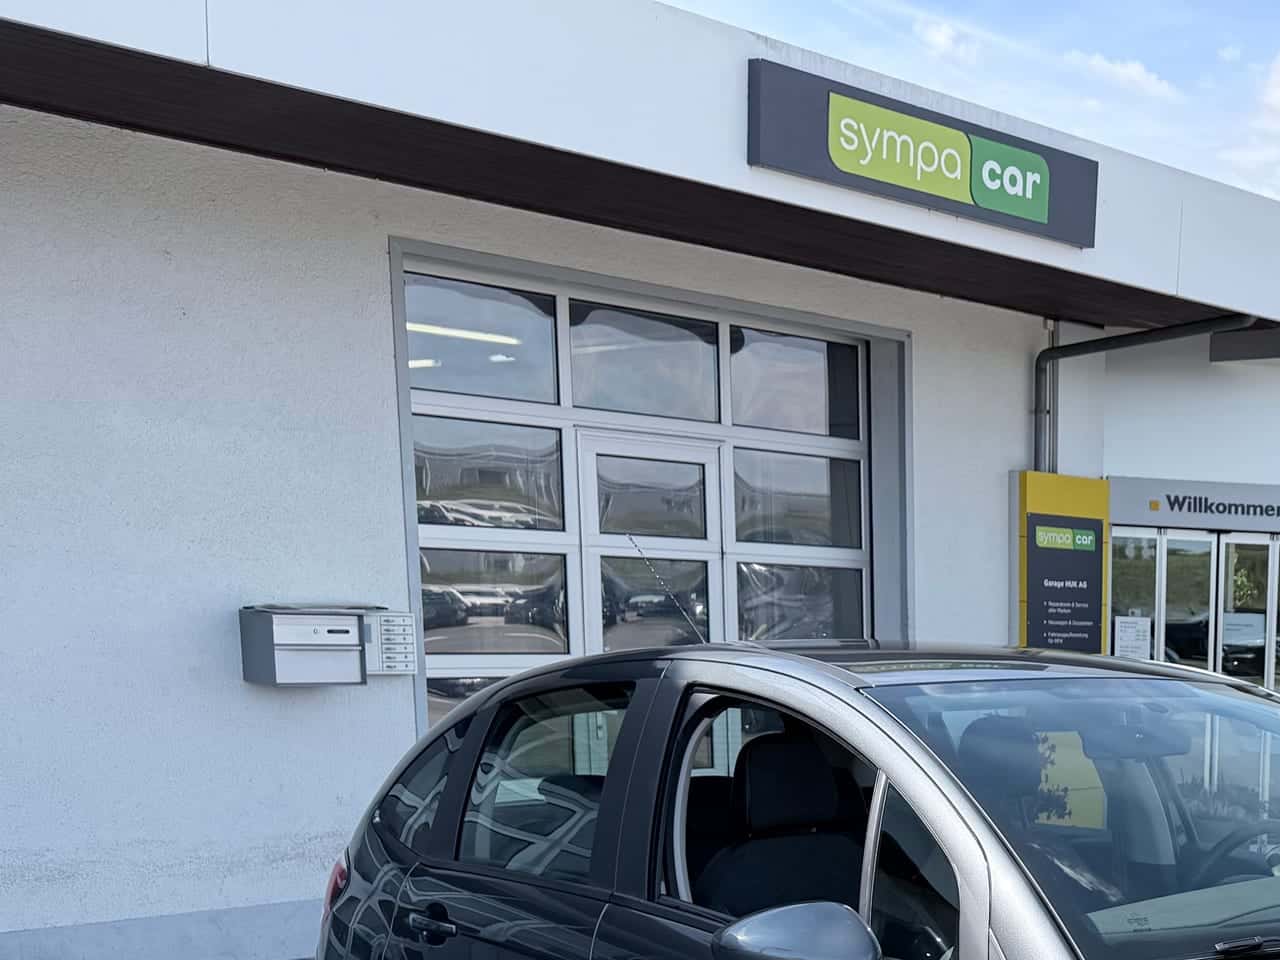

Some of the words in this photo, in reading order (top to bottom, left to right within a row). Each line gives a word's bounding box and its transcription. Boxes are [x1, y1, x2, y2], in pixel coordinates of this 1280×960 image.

[839, 117, 962, 181] sympa
[981, 160, 1041, 200] car
[1075, 535, 1093, 545] car
